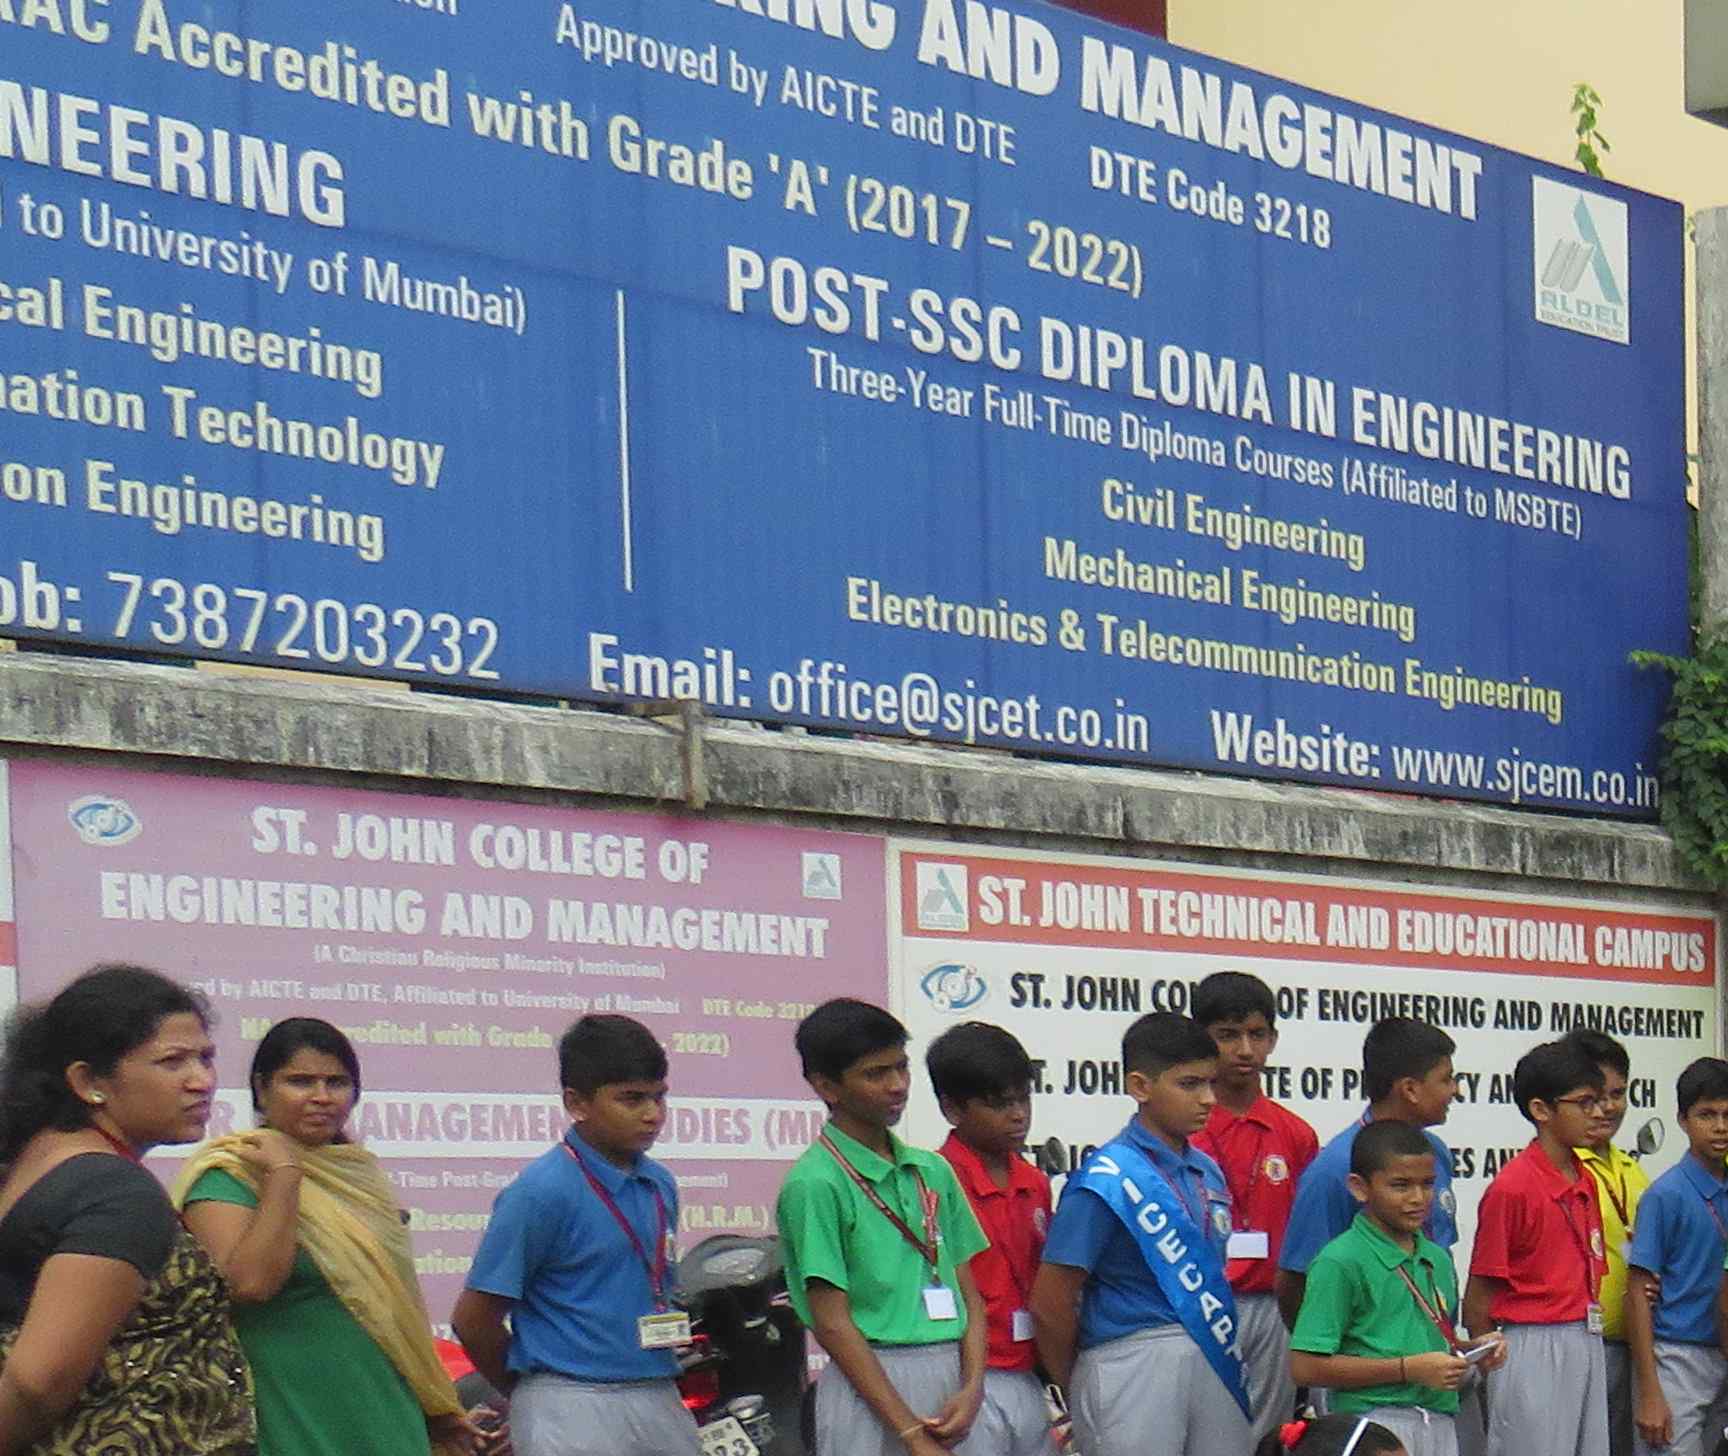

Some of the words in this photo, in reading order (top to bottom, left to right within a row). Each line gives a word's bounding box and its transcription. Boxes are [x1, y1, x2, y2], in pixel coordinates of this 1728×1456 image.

[556, 3, 718, 87] Approved
[730, 50, 768, 106] by
[781, 65, 880, 129] AICTE
[890, 105, 944, 146] and
[955, 112, 1016, 166] DTE
[917, 0, 1060, 96] AND
[1081, 35, 1482, 221] MANAGEMENT
[0, 80, 345, 228] NEERING
[134, 0, 451, 127] Accredited
[466, 89, 589, 161] with
[608, 114, 753, 200] Grade
[769, 153, 829, 217] 'A'
[847, 174, 971, 251] (2017
[1026, 219, 1143, 299] 2022)
[1090, 145, 1157, 203] DTE
[1168, 168, 1244, 226] Code
[1255, 190, 1332, 250] 3218
[18, 193, 64, 240] to
[81, 199, 293, 294] University
[308, 251, 348, 295] of
[362, 256, 527, 335] Mumbai)
[83, 284, 383, 399] Engineering
[727, 244, 1021, 372] POST-SSC
[1040, 315, 1273, 425] DIPLOMA
[1289, 372, 1337, 438] IN
[1353, 386, 1631, 499] ENGINEERING
[161, 384, 445, 489] Technology
[806, 346, 974, 419] Three-Year
[984, 383, 1111, 445] Full-Time
[1122, 412, 1226, 469] Diploma
[1236, 435, 1334, 488] Courses
[1342, 457, 1457, 513] (Affiliated
[1466, 489, 1487, 518] to
[1495, 488, 1582, 541] MSBTE)
[84, 459, 384, 563] Engineering
[1102, 478, 1174, 530] Civil
[1186, 495, 1365, 572] Engineering
[107, 570, 501, 680] 7387203232
[1044, 536, 1231, 606] Mechanical
[1243, 569, 1415, 644] Engineering
[847, 576, 1048, 647] Electronics
[1059, 607, 1086, 652] &
[1097, 612, 1395, 695] Telecommunication
[1405, 658, 1563, 726] Engineering
[588, 631, 752, 709] Email:
[768, 657, 1149, 753] office@sjcet.co.in
[1210, 709, 1381, 779] Website:
[1391, 743, 1659, 809] www.sjcem.co.in
[252, 805, 319, 856] ST.
[332, 812, 455, 865] JOHN
[469, 823, 646, 880] COLLEGE
[658, 840, 710, 884] OF
[100, 871, 427, 936] ENGINEERING
[441, 892, 534, 940] AND
[548, 898, 830, 959] MANAGEMENT
[977, 873, 1031, 927] ST.
[1039, 881, 1130, 934] JOHN
[1137, 887, 1320, 946] TECHNICAL
[1327, 903, 1390, 952] AND
[1397, 909, 1589, 965] EDUCATIONAL
[1594, 925, 1706, 973] CAMPUS
[249, 980, 304, 999] AICTE
[1010, 972, 1052, 1010] ST.
[1061, 974, 1140, 1012] JOHN
[1278, 987, 1308, 1020] OF
[1318, 987, 1488, 1029] ENGINEERING
[1494, 998, 1543, 1031] AND
[1550, 1002, 1704, 1040] MANAGEMENT
[1301, 1068, 1333, 1101] OF
